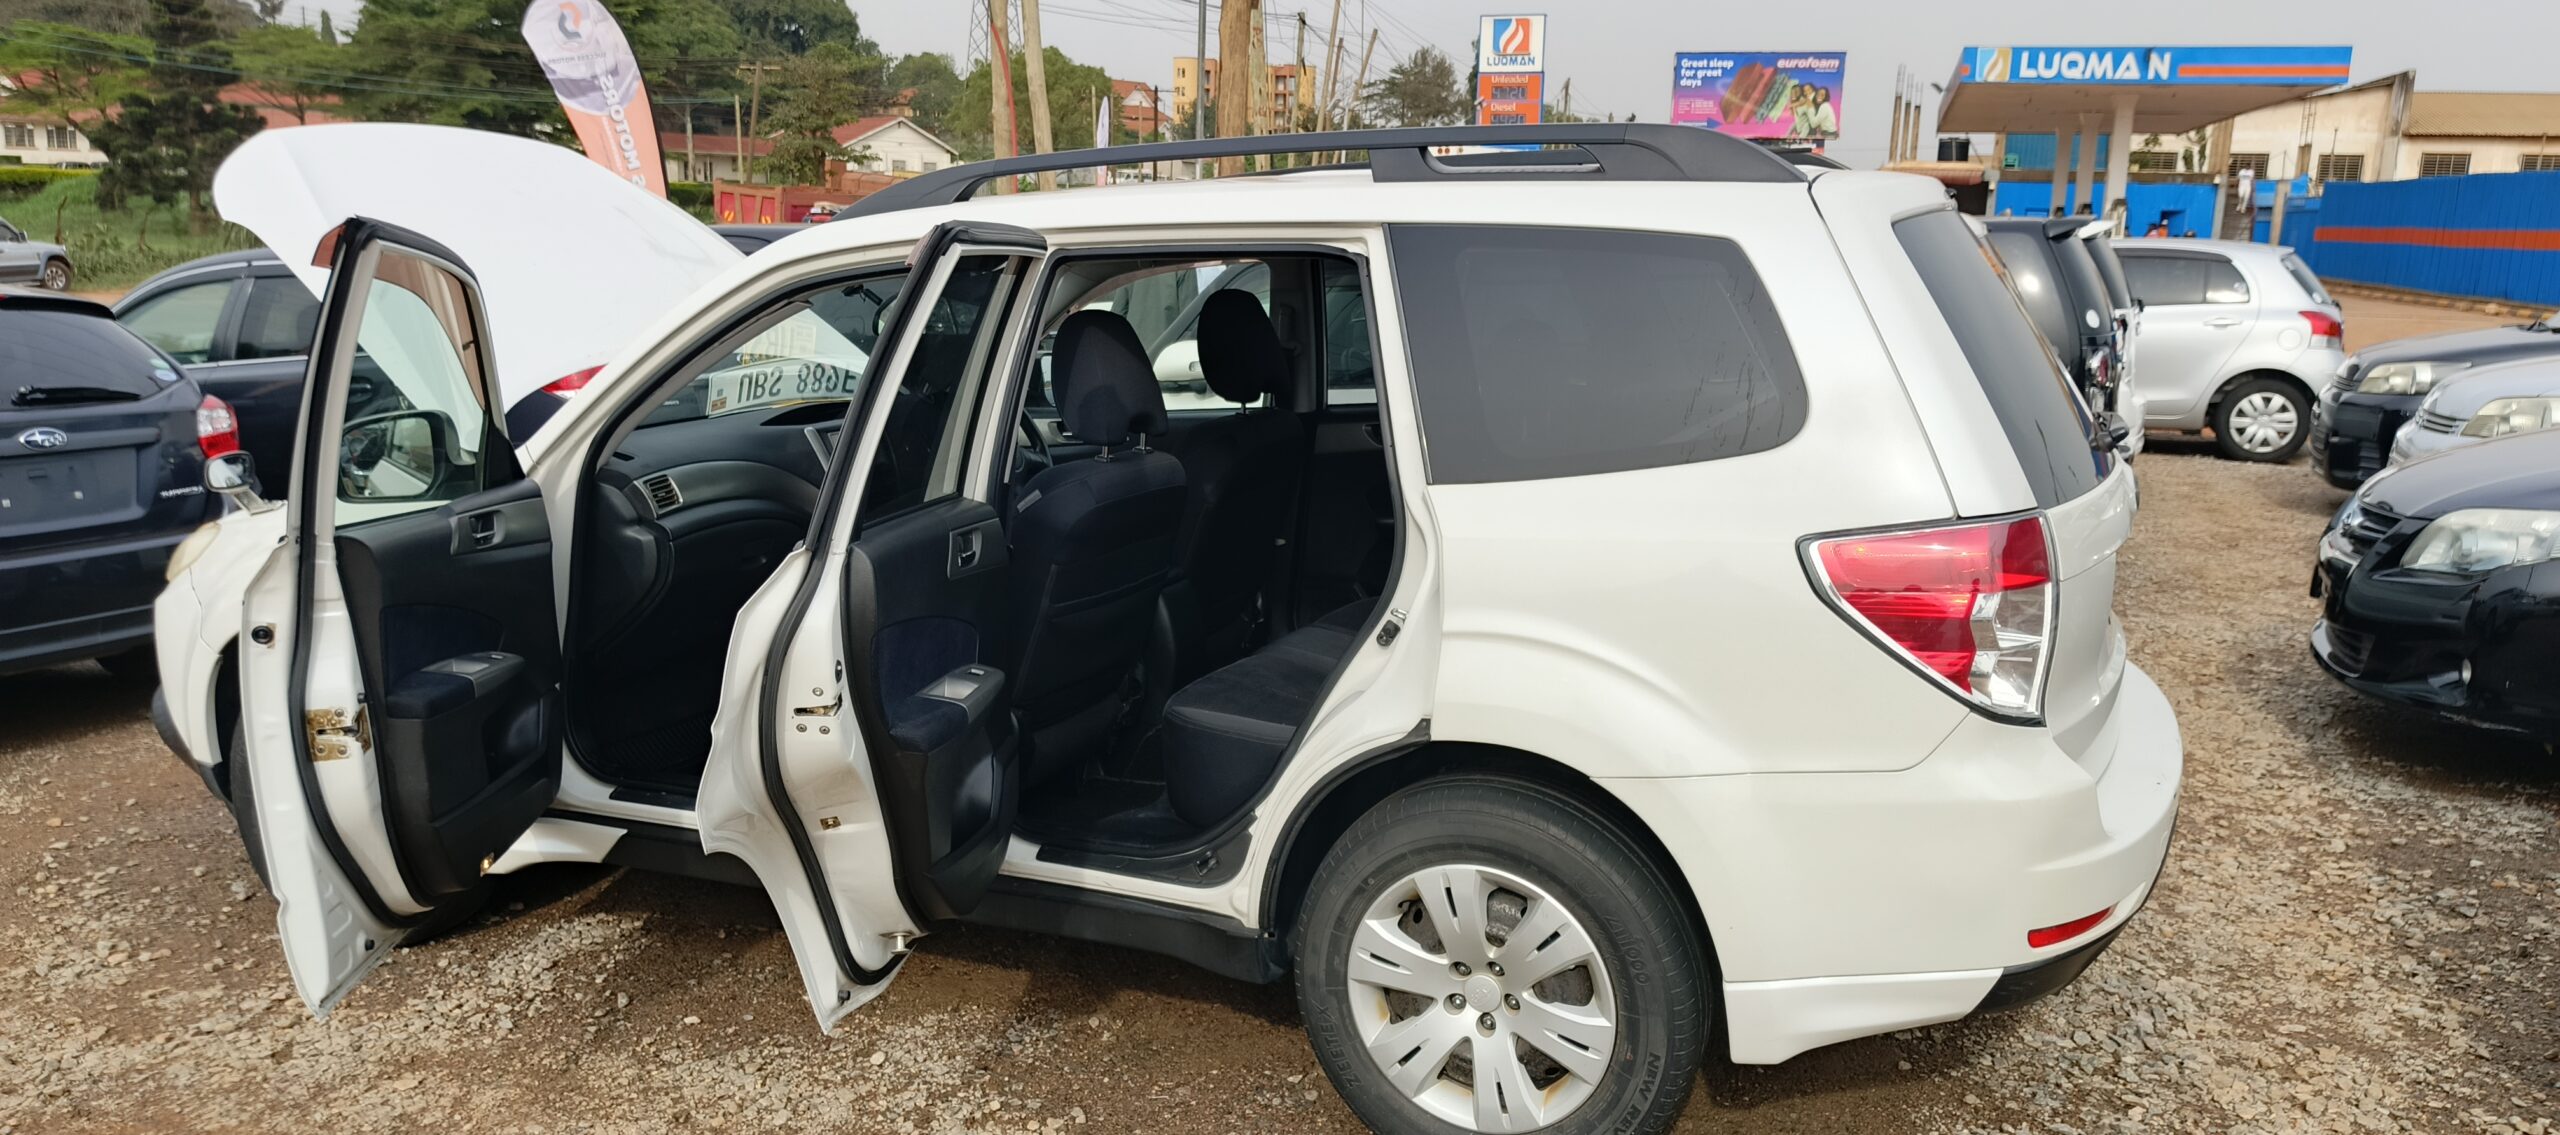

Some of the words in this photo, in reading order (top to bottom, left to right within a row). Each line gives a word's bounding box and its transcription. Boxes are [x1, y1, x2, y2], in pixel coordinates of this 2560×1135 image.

[1487, 56, 1536, 66] LUQMAN
[1681, 58, 1708, 68] Great
[1709, 58, 1734, 69] sleep
[1776, 57, 1840, 69] eurofoam
[1680, 68, 1696, 77] for
[1697, 69, 1722, 78] great
[1491, 75, 1529, 84] Unleaded
[1680, 77, 1702, 88] days
[1490, 103, 1517, 112] Diesel
[1311, 999, 1362, 1089] ZEETEX
[1639, 1052, 1661, 1101] NEW
